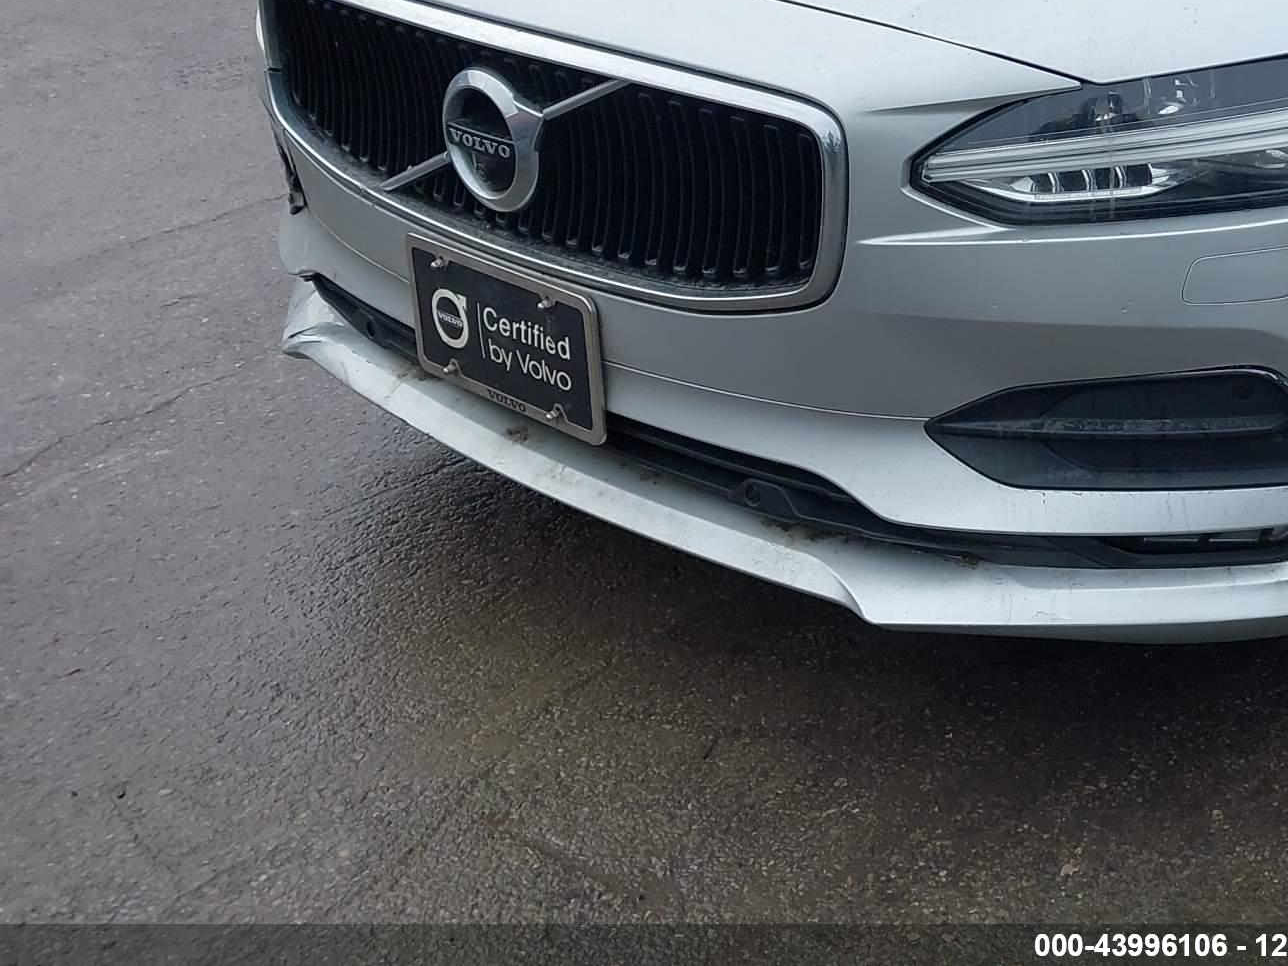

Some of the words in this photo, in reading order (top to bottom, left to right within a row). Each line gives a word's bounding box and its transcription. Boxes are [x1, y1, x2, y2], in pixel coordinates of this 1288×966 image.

[448, 127, 511, 159] VOLVO
[438, 311, 464, 328] VOLVO
[483, 307, 571, 360] Certified
[488, 338, 513, 372] by
[516, 349, 572, 391] Volvo
[487, 388, 528, 413] VOLVO
